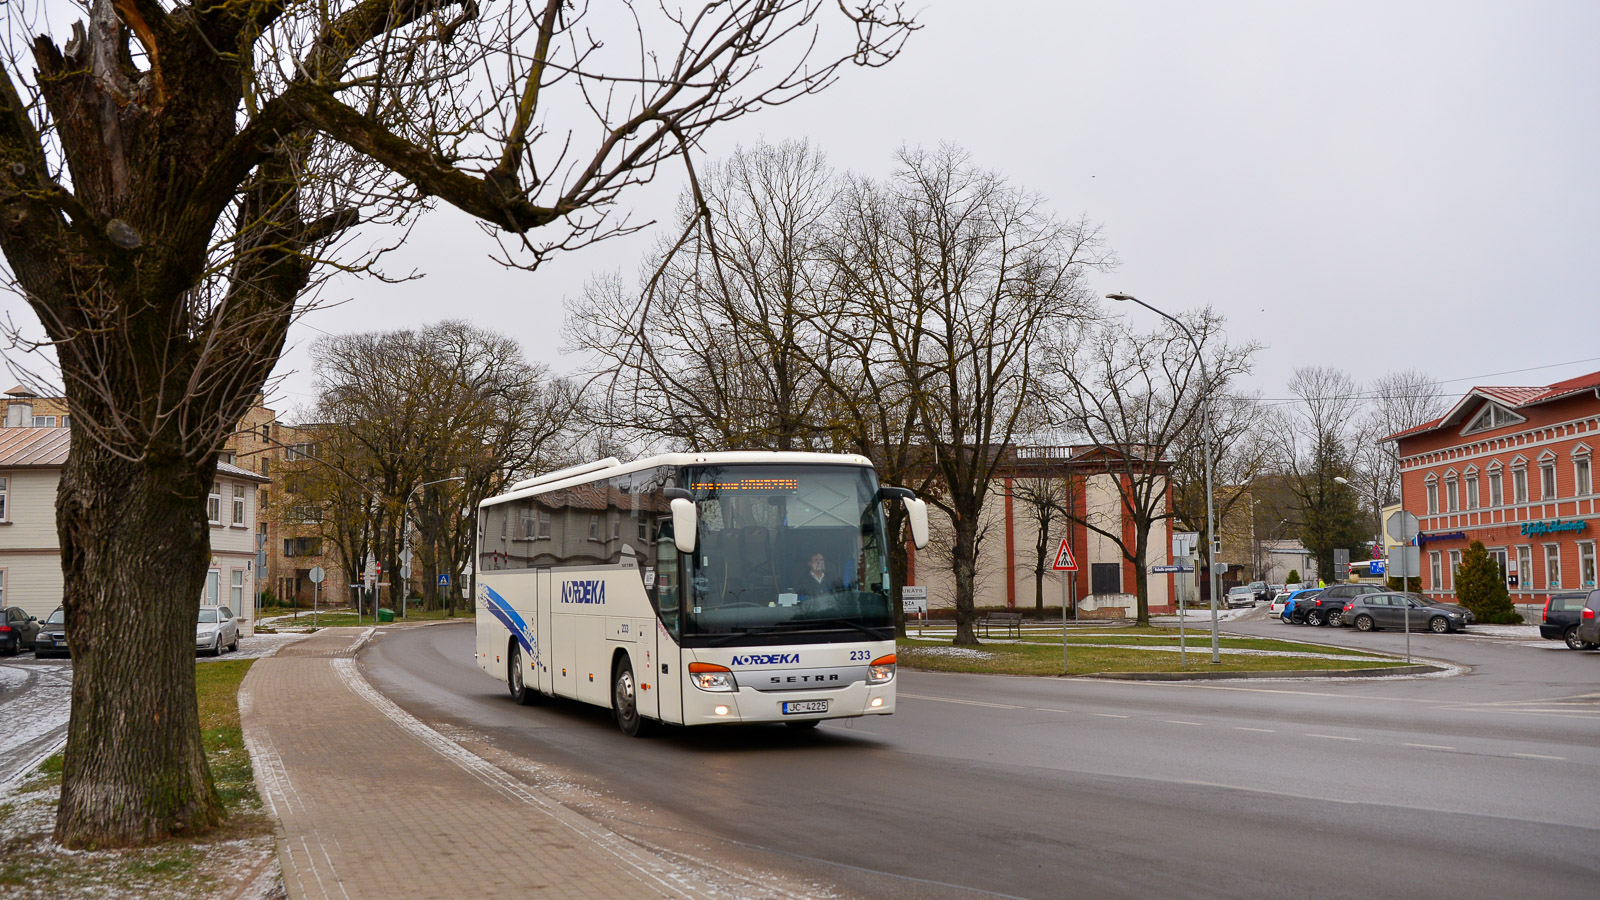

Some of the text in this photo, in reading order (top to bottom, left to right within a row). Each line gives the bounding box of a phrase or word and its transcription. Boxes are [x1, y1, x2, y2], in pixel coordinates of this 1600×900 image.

[561, 580, 605, 604] NORDEKA
[731, 653, 800, 665] NORDEKA
[850, 650, 870, 661] 233
[770, 674, 838, 683] SETRA
